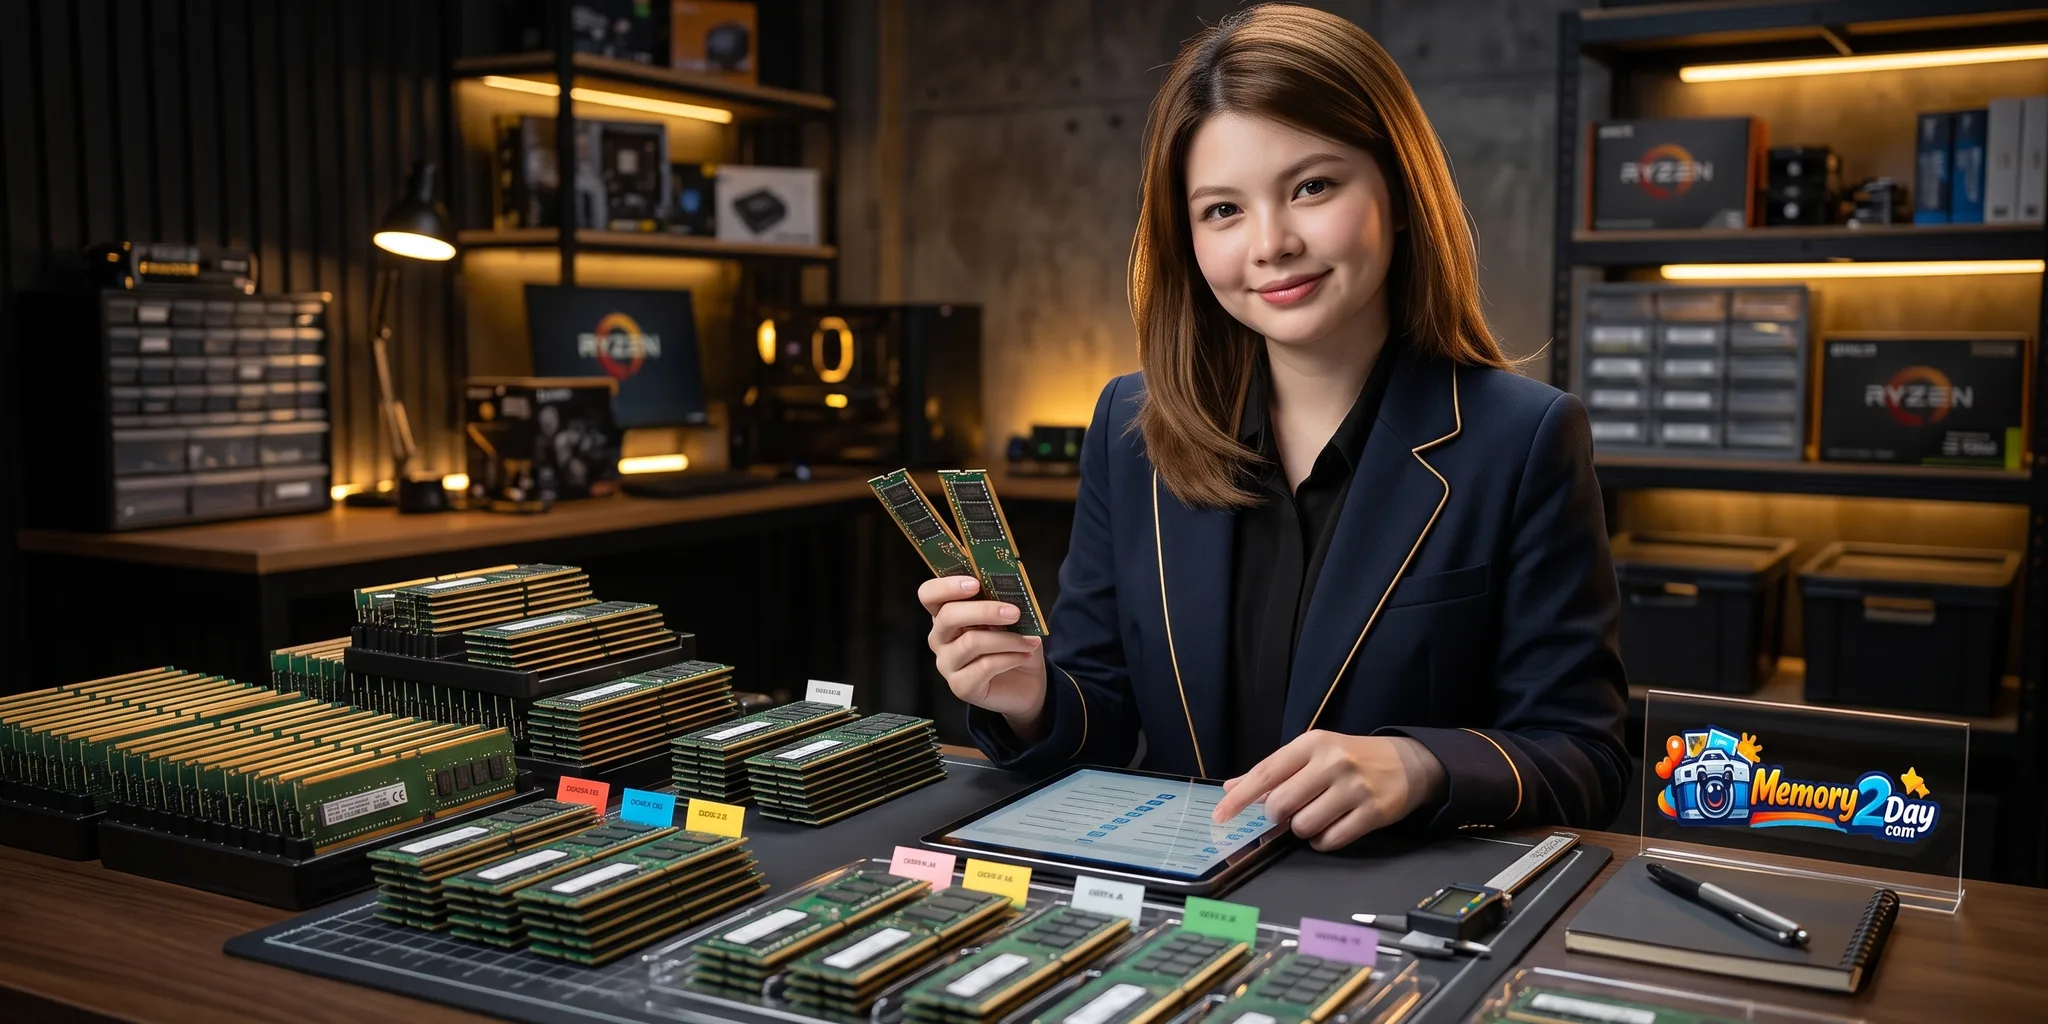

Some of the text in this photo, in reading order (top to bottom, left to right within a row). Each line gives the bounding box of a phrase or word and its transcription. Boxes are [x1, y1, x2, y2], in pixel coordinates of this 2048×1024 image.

[1620, 161, 1713, 183] RYZEN
[578, 333, 661, 359] RYZEN
[1865, 385, 1973, 408] RYZEN
[1751, 768, 1935, 833] Memory2Day
